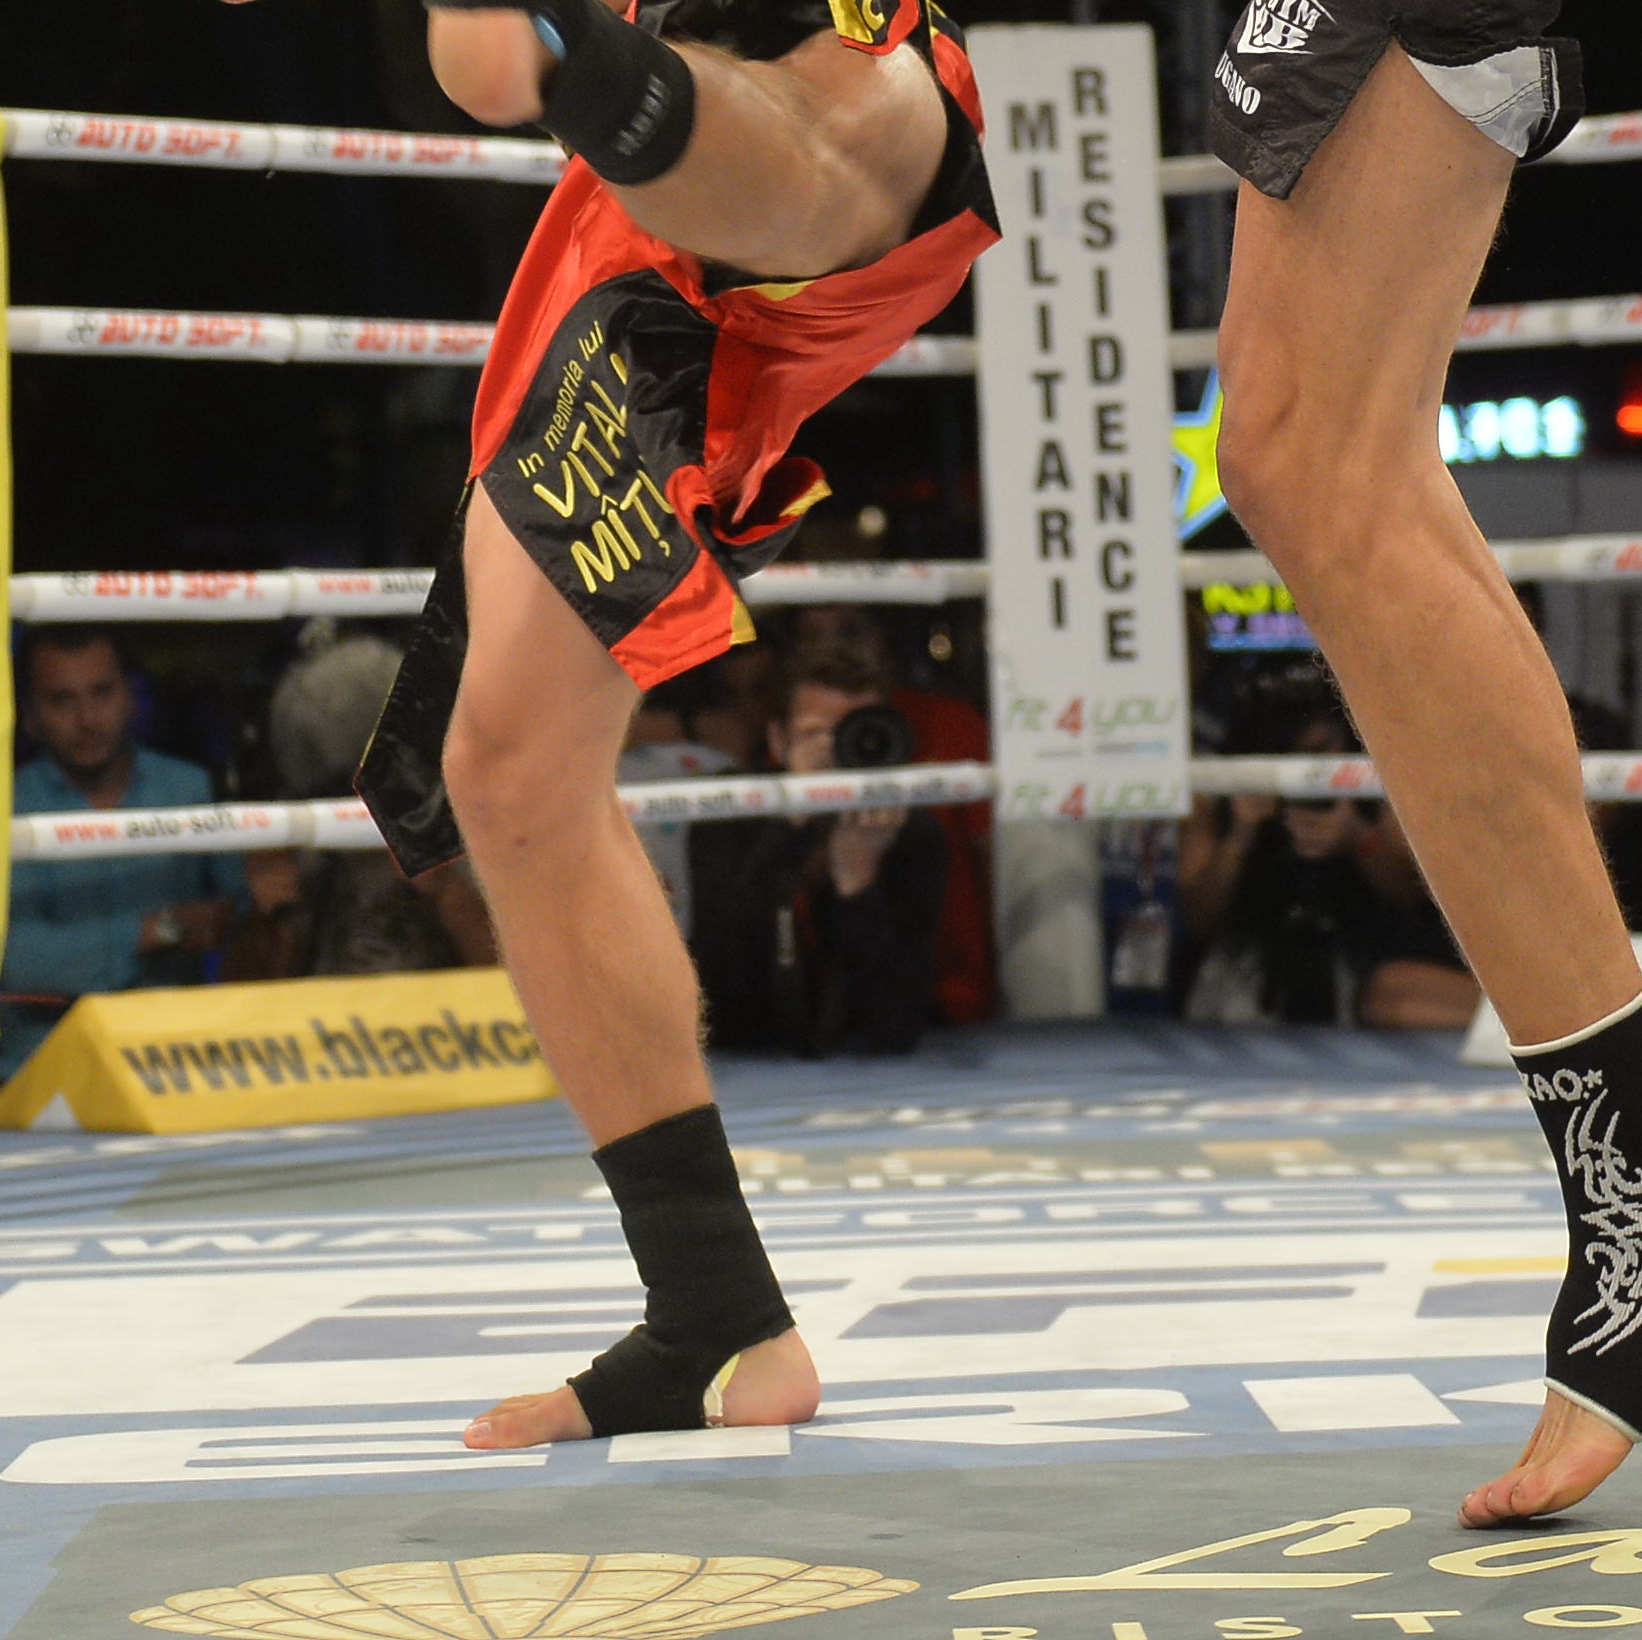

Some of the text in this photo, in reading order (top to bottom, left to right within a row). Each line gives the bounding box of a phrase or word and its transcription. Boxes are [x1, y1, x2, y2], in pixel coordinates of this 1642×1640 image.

[1213, 50, 1262, 116] UGANO
[516, 320, 604, 479] In memoria lui
[1007, 101, 1075, 631] MILITARI
[1071, 66, 1137, 663] RESIDENCE
